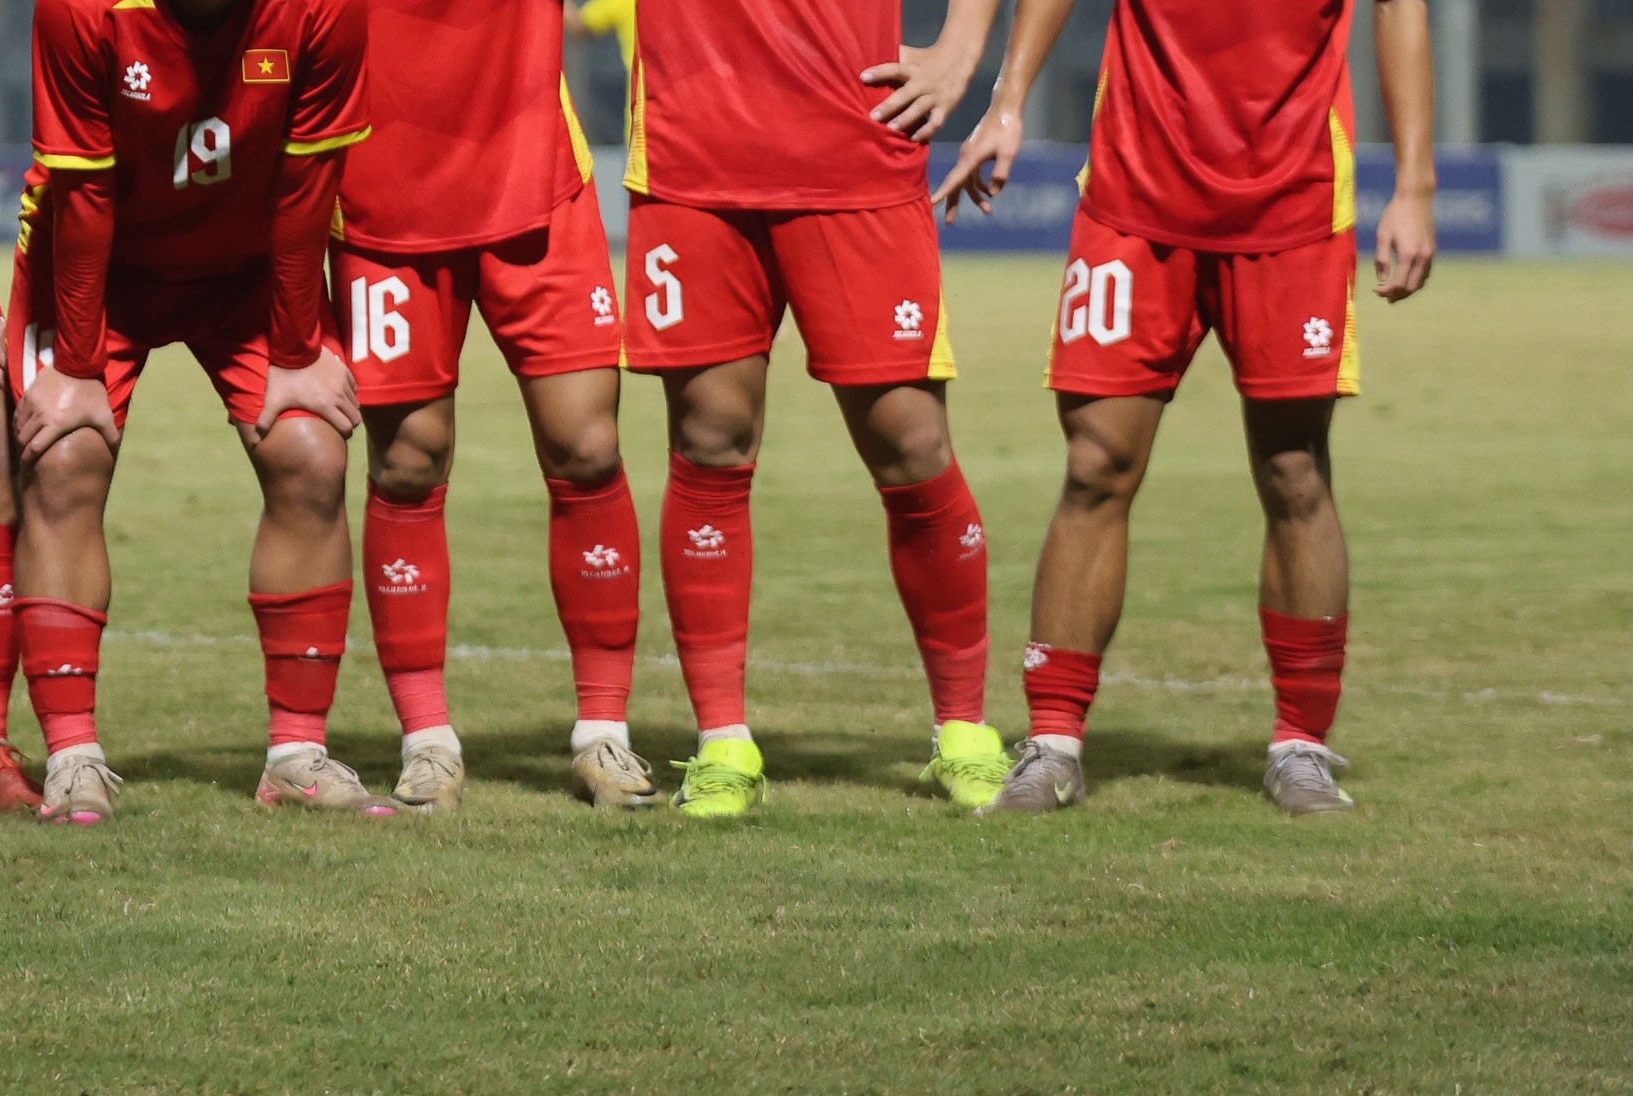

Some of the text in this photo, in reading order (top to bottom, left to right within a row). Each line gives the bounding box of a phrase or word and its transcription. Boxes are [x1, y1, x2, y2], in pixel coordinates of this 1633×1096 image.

[174, 117, 232, 189] 19
[351, 276, 410, 363] 16
[644, 243, 684, 331] 5
[1059, 257, 1133, 347] 20
